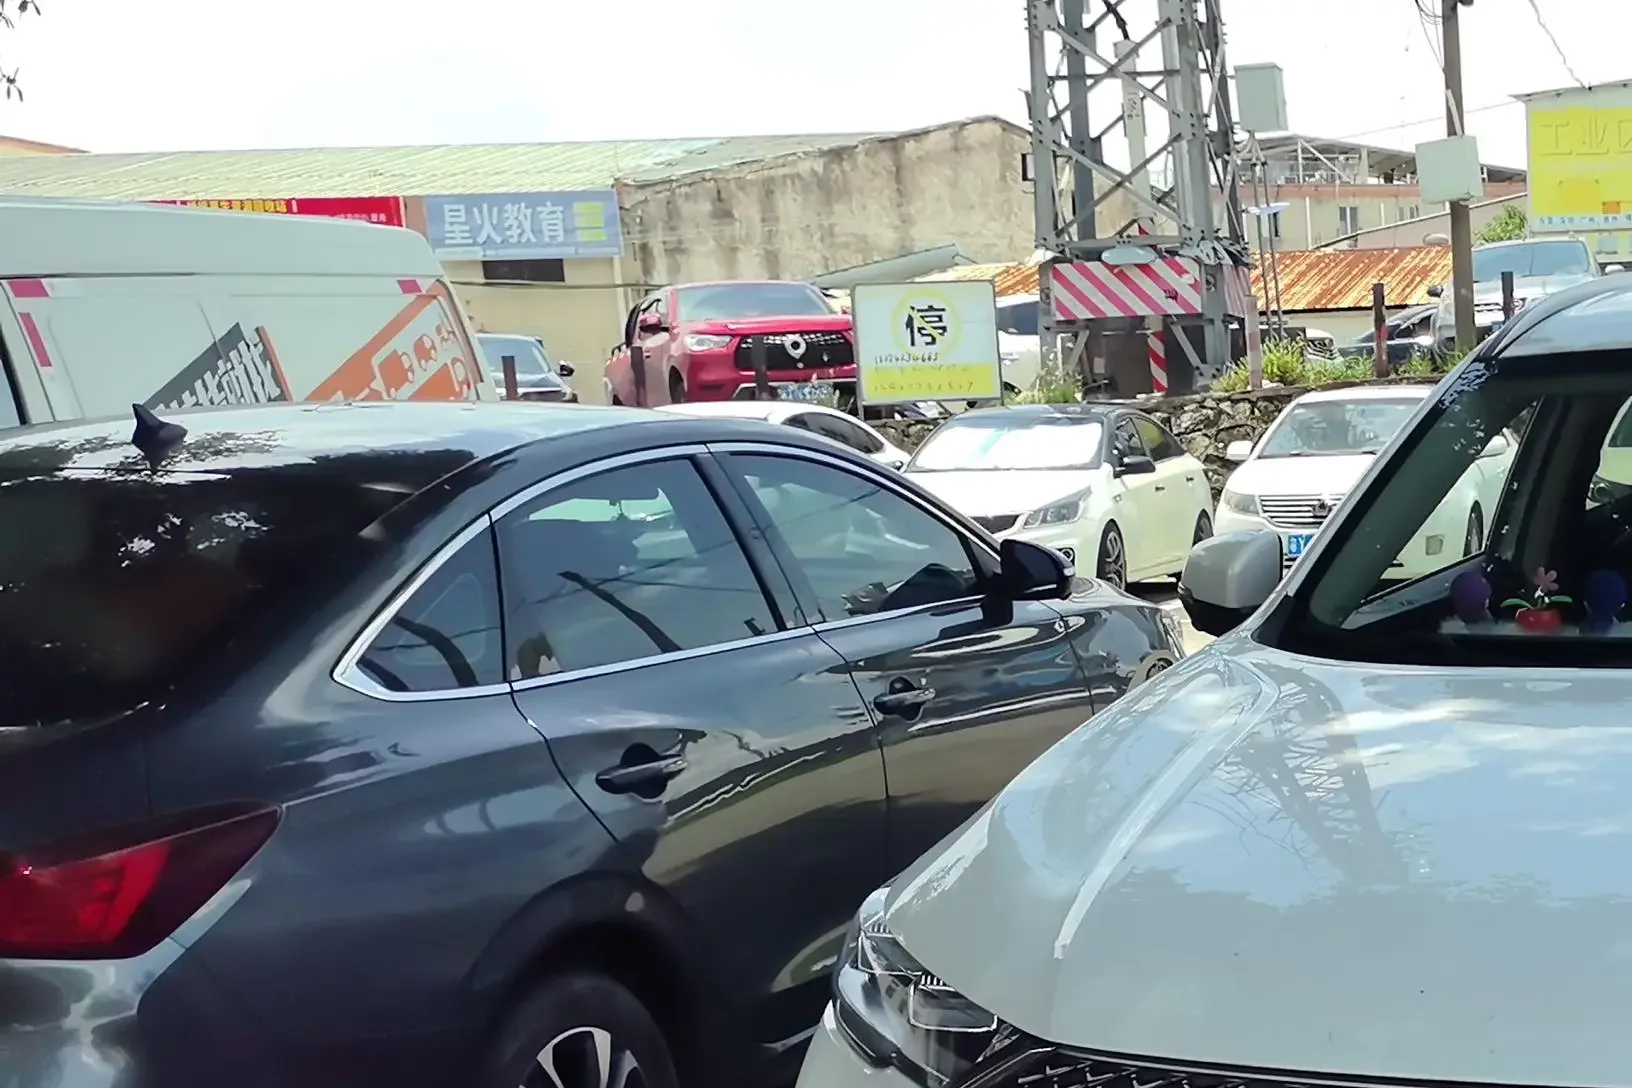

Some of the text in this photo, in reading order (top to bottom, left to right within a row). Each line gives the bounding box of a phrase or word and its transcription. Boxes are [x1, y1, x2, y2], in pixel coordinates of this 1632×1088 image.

[443, 201, 565, 245] 星火教育
[905, 304, 948, 347] 停
